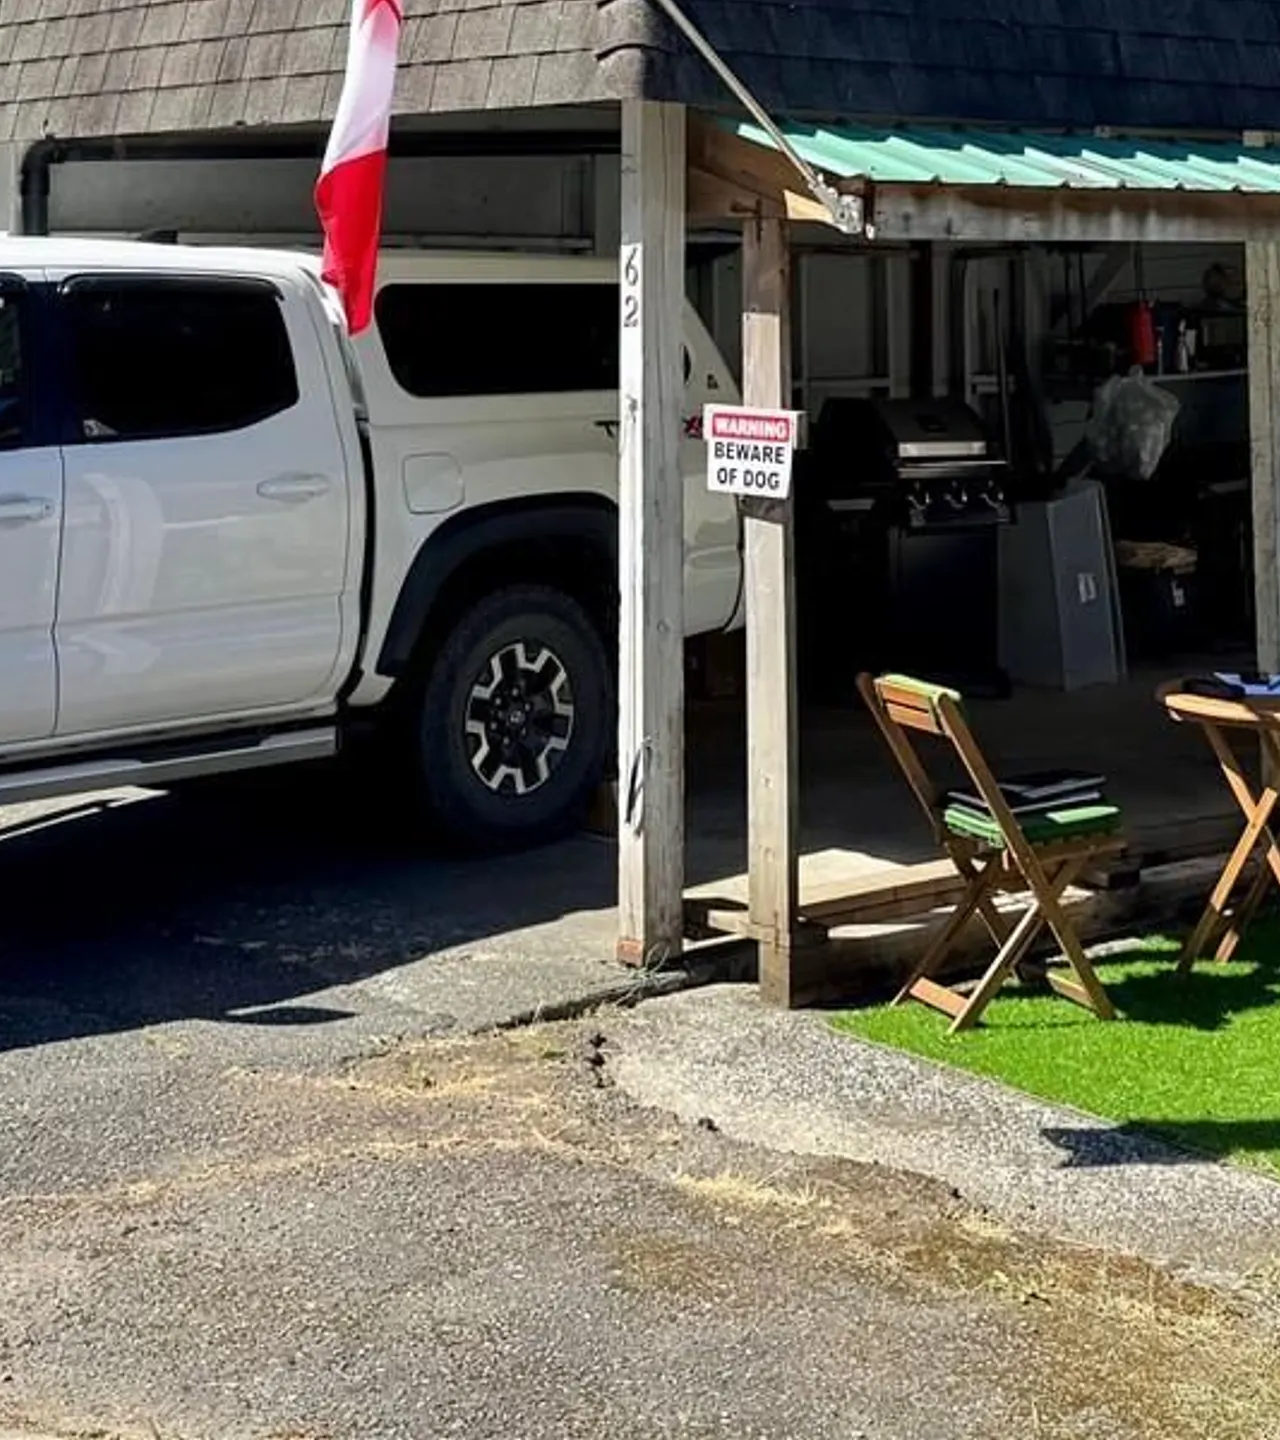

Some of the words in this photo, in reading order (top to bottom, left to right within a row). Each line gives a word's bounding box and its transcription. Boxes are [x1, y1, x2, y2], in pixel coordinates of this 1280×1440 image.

[623, 247, 639, 328] 62
[716, 416, 787, 440] WARNING
[714, 441, 785, 464] BEWARE
[716, 467, 738, 486] OF
[743, 469, 780, 490] DOG
